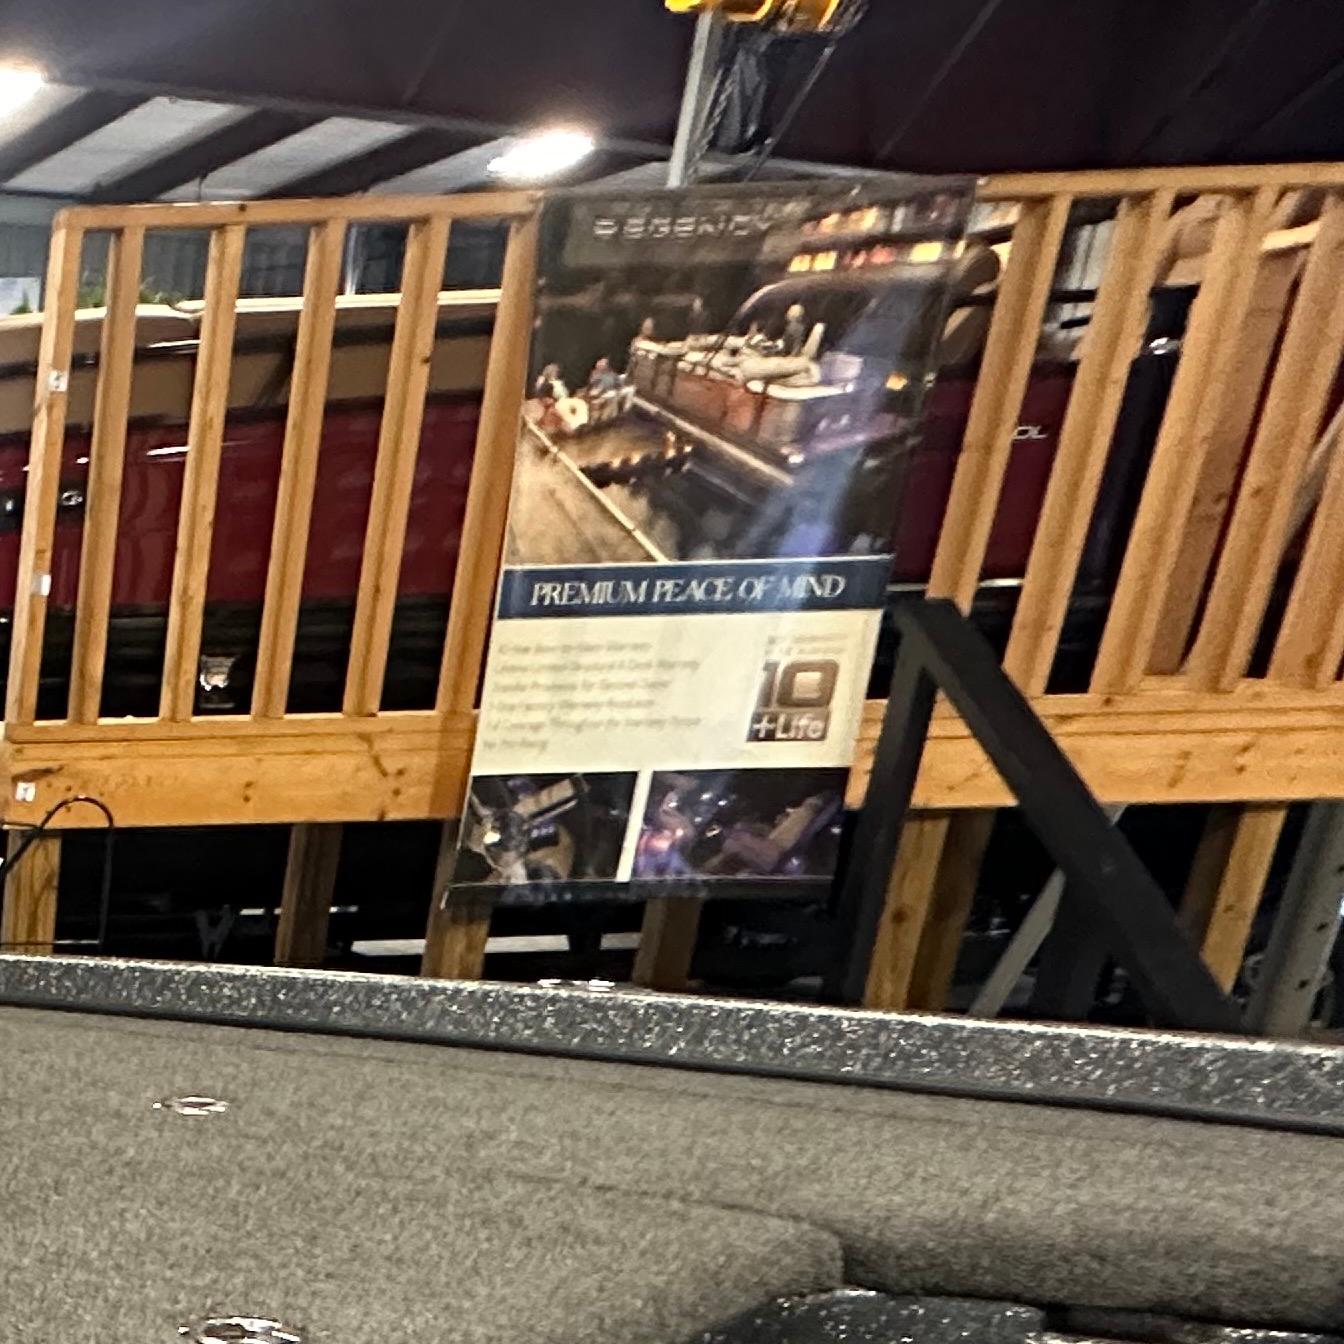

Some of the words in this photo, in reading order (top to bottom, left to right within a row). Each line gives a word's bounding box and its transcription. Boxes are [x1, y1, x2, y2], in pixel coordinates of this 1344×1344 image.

[530, 579, 650, 606] PREMIUM
[652, 576, 735, 603] PEACE
[737, 575, 776, 600] OF
[778, 573, 847, 599] MIND
[755, 658, 840, 710] 10
[752, 714, 825, 740] +Life
